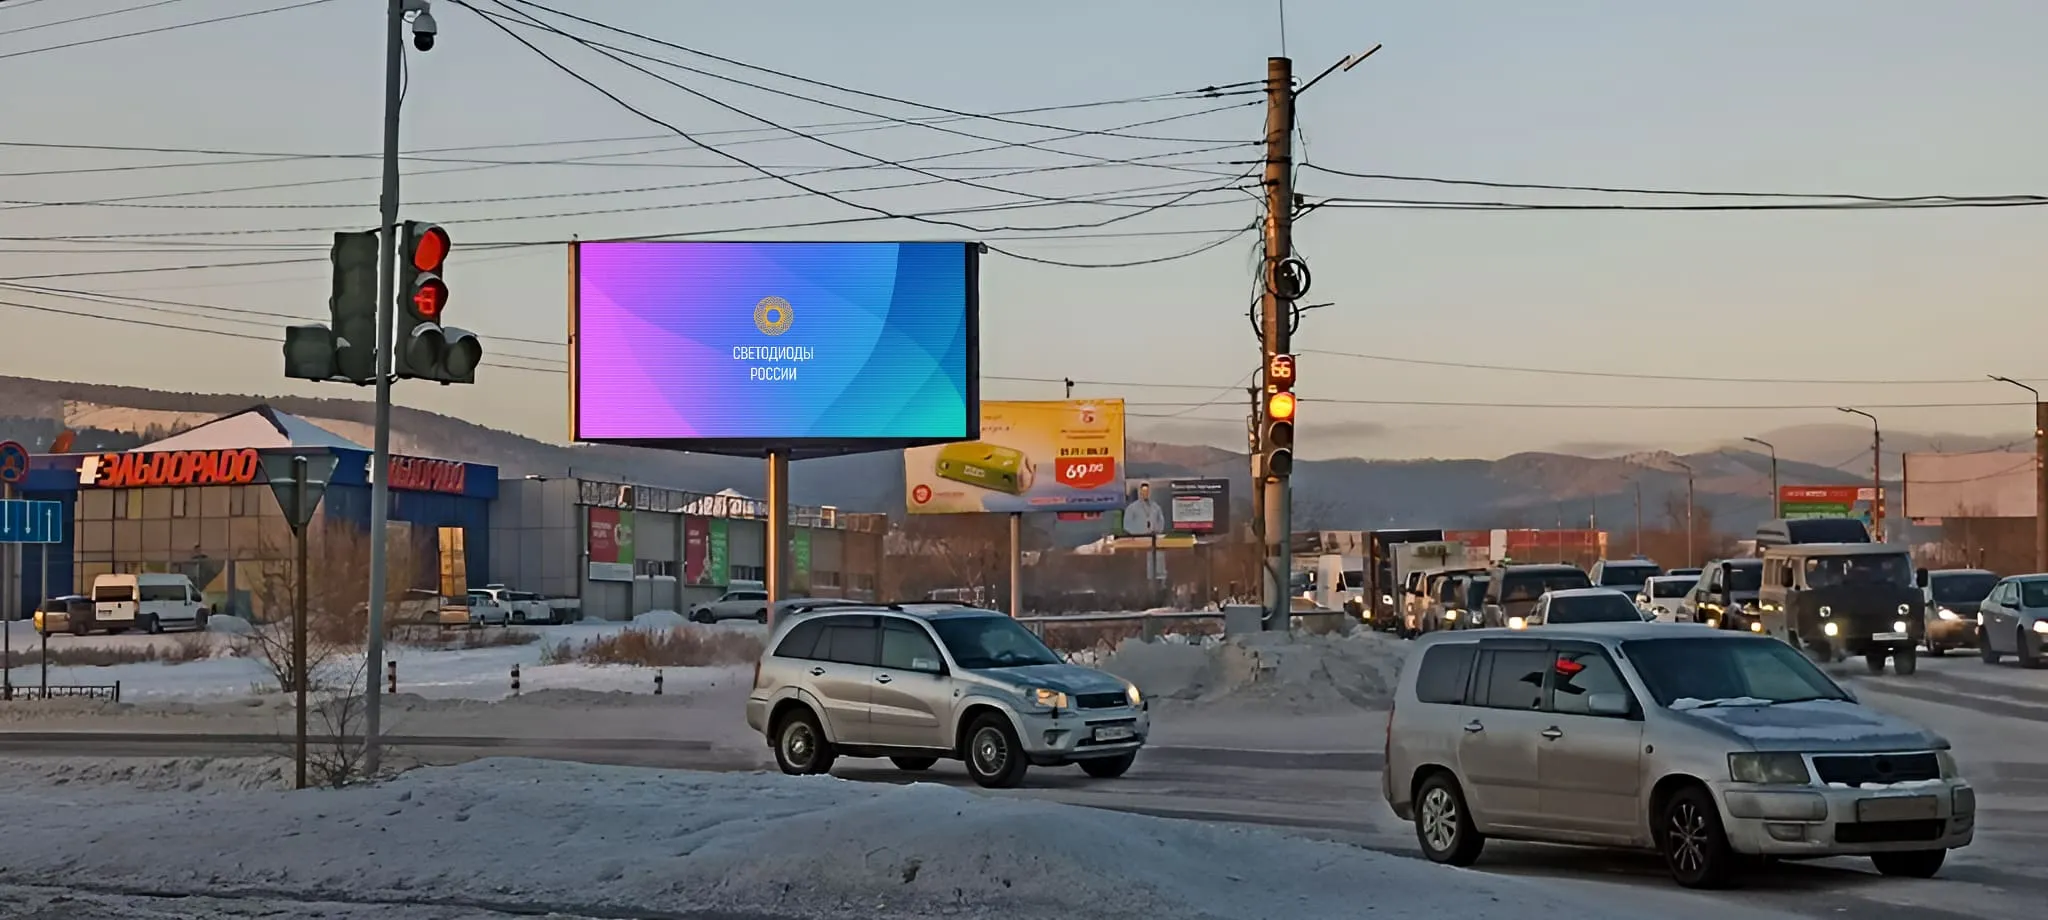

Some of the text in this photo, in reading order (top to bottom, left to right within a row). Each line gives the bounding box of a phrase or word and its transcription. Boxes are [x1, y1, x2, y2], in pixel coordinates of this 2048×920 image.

[733, 346, 814, 361] СВЕТОДИОДЫ
[750, 367, 797, 381] РОССИИ
[1066, 464, 1087, 479] 69
